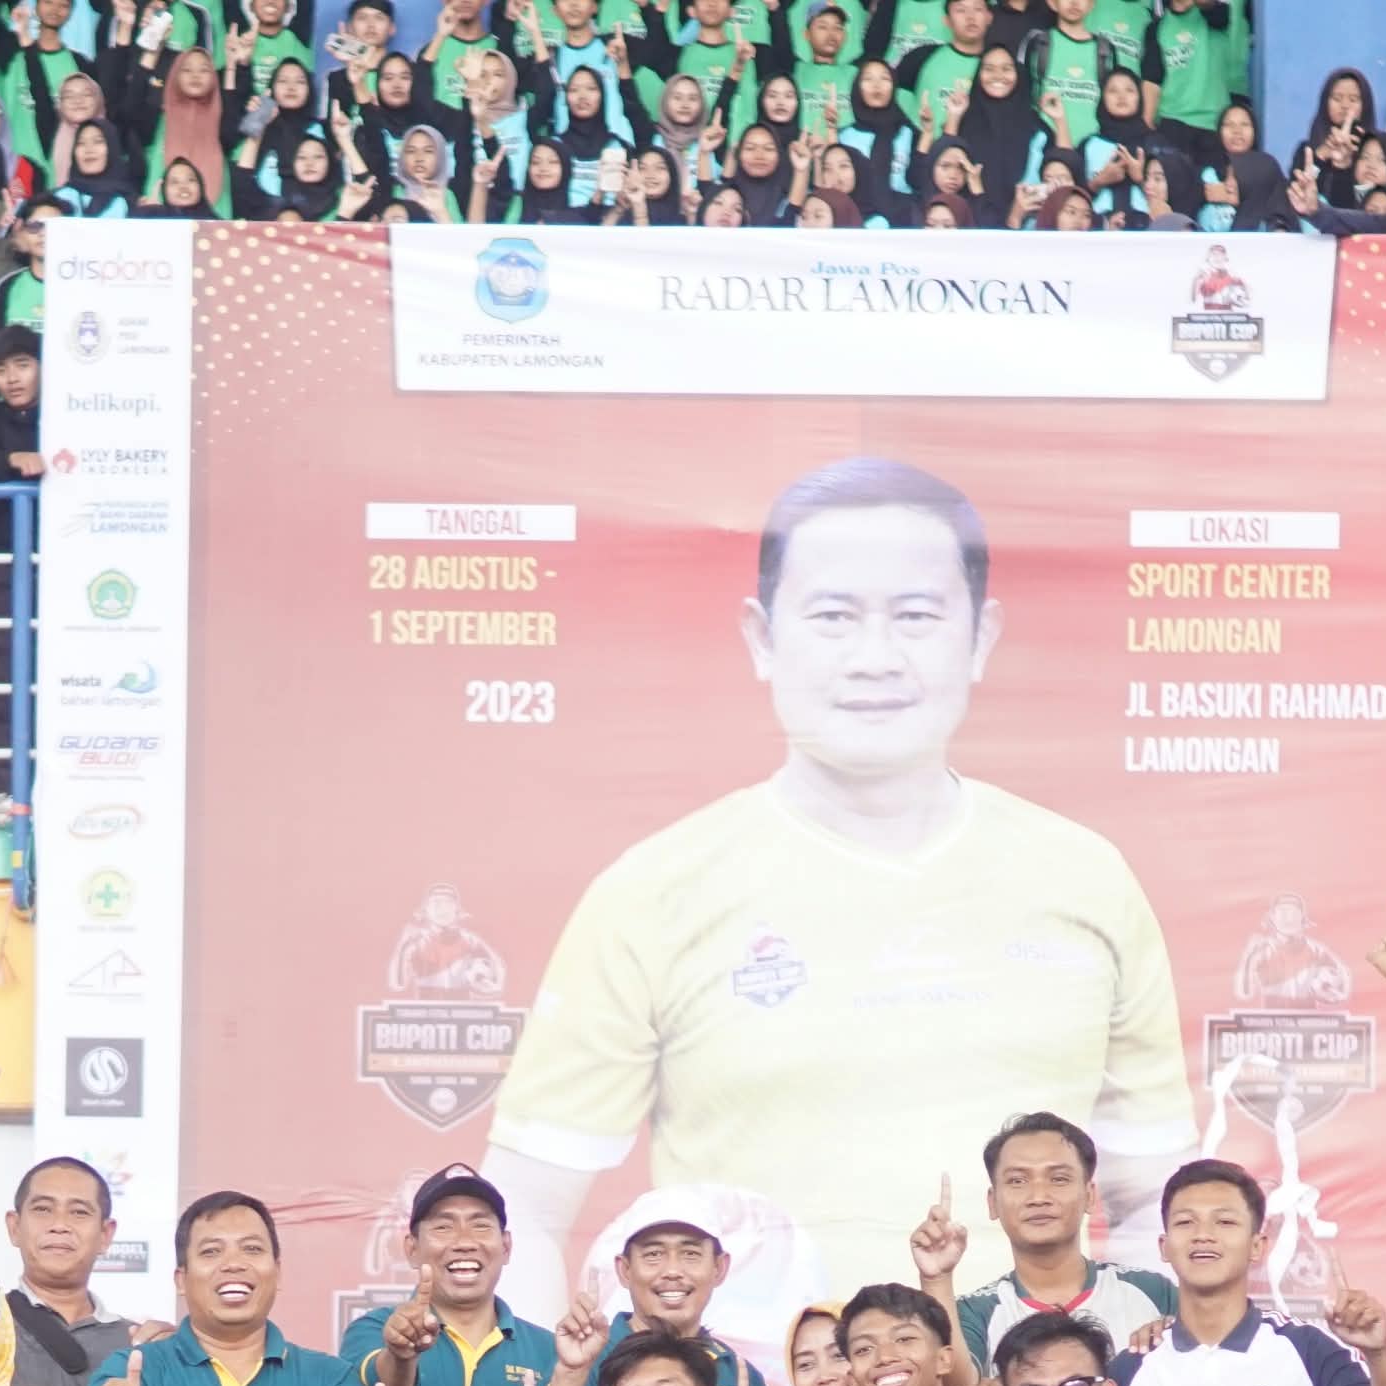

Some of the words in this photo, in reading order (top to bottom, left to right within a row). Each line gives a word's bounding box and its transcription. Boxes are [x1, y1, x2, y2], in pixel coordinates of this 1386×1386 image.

[811, 261, 870, 276] Jawa
[880, 263, 922, 276] Pos
[658, 275, 810, 313] RADAR
[819, 276, 1074, 316] LAMONGAN
[461, 333, 562, 347] PEMERINTAH
[418, 352, 510, 368] KABUPATEN
[513, 354, 605, 369] LAMONGAN
[67, 392, 162, 417] belikopi.
[81, 449, 110, 463] LYLY
[114, 449, 168, 463] BAKERY
[426, 508, 529, 536] TANGGAL
[1189, 516, 1270, 544] LOKASI
[369, 554, 407, 591] 28
[412, 554, 539, 592] AGUSTUS
[1127, 562, 1218, 599] SPORT
[1224, 563, 1332, 600] CENTER
[369, 609, 384, 644] 1
[391, 609, 559, 647] SEPTEMBER
[1127, 616, 1283, 655] LAMONGAN
[465, 679, 557, 725] 2023
[1124, 681, 1156, 719] JL
[1160, 681, 1263, 719] BASUKI
[1124, 736, 1282, 774] LAMONGAN
[375, 1023, 458, 1050] BUPATI
[466, 1024, 513, 1051] CUP
[1221, 1031, 1304, 1060] BUPATI
[1312, 1033, 1359, 1060] CUP
